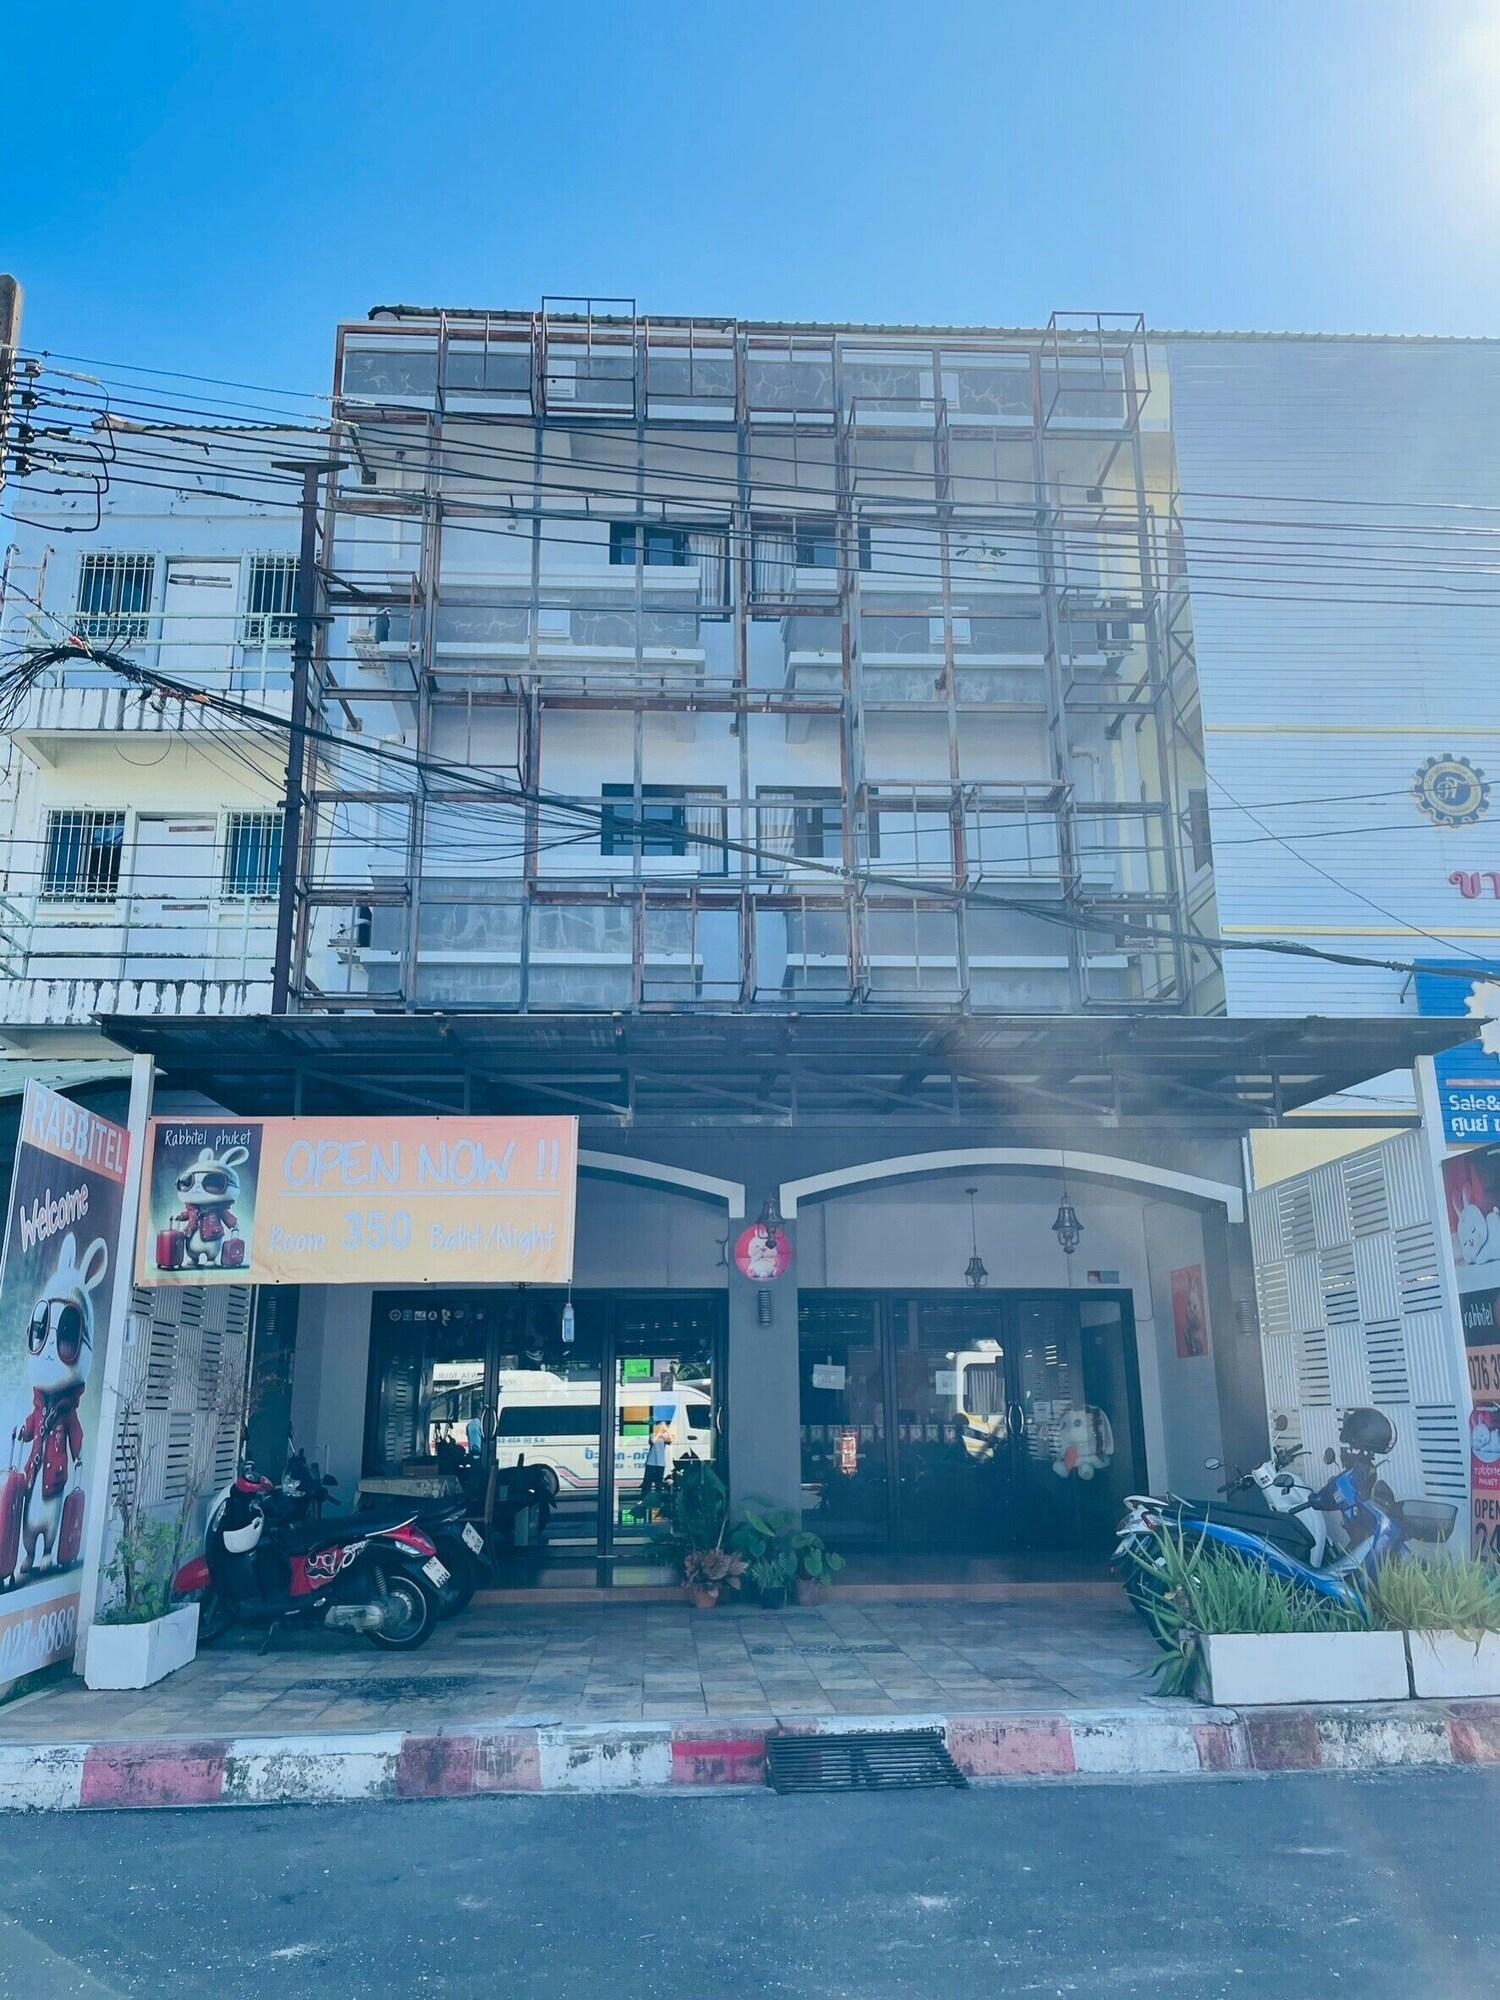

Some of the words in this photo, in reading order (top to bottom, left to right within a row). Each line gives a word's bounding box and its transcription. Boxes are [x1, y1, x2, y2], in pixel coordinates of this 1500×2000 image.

[29, 1089, 123, 1175] RABBITEL
[164, 1129, 207, 1146] Rabbitel
[216, 1129, 251, 1151] phuket
[283, 1140, 400, 1187] OPEN
[416, 1139, 516, 1186] NOW
[20, 1183, 90, 1252] Welcome
[271, 1223, 327, 1253] Room
[341, 1210, 413, 1251] 350
